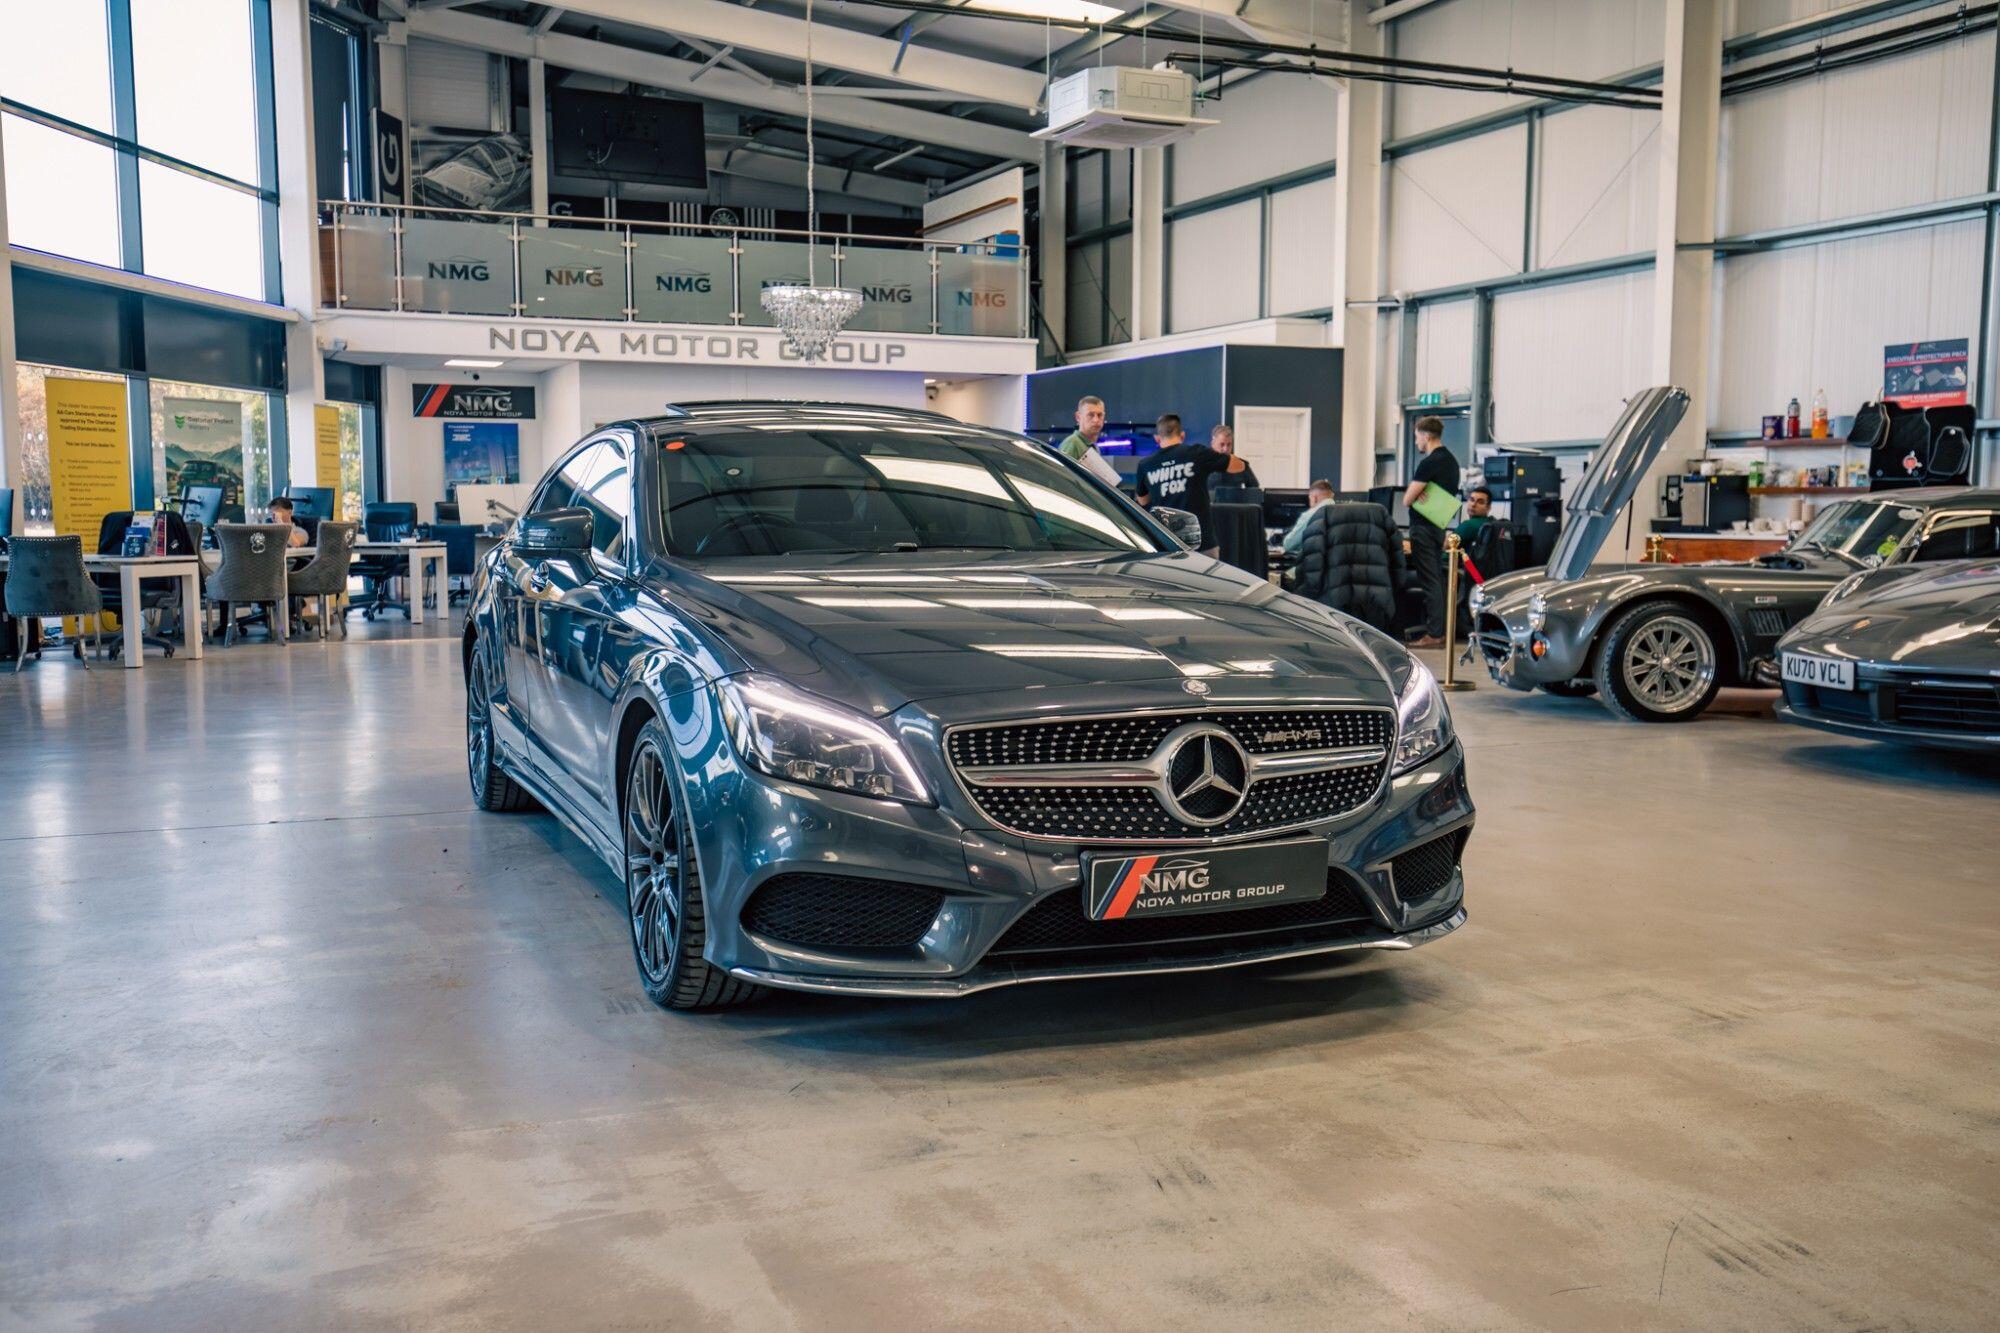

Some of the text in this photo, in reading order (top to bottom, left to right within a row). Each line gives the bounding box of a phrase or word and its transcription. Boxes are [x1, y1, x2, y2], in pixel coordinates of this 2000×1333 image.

[428, 262, 490, 281] NMG
[545, 269, 604, 287] NMG
[656, 275, 711, 293] NMG
[862, 286, 912, 303] NMG
[957, 291, 1006, 308] NMG
[489, 328, 600, 352] NOYA
[620, 332, 760, 359] MOTOR
[1916, 351, 1951, 361] PROTECTION
[453, 395, 513, 411] NMG
[1147, 462, 1195, 485] WHITE
[1160, 478, 1187, 497] FOX
[1786, 656, 1846, 685] KU70 VCL
[1139, 868, 1210, 894] NMG
[1137, 884, 1285, 908] NOYA MOTOR GROUP
